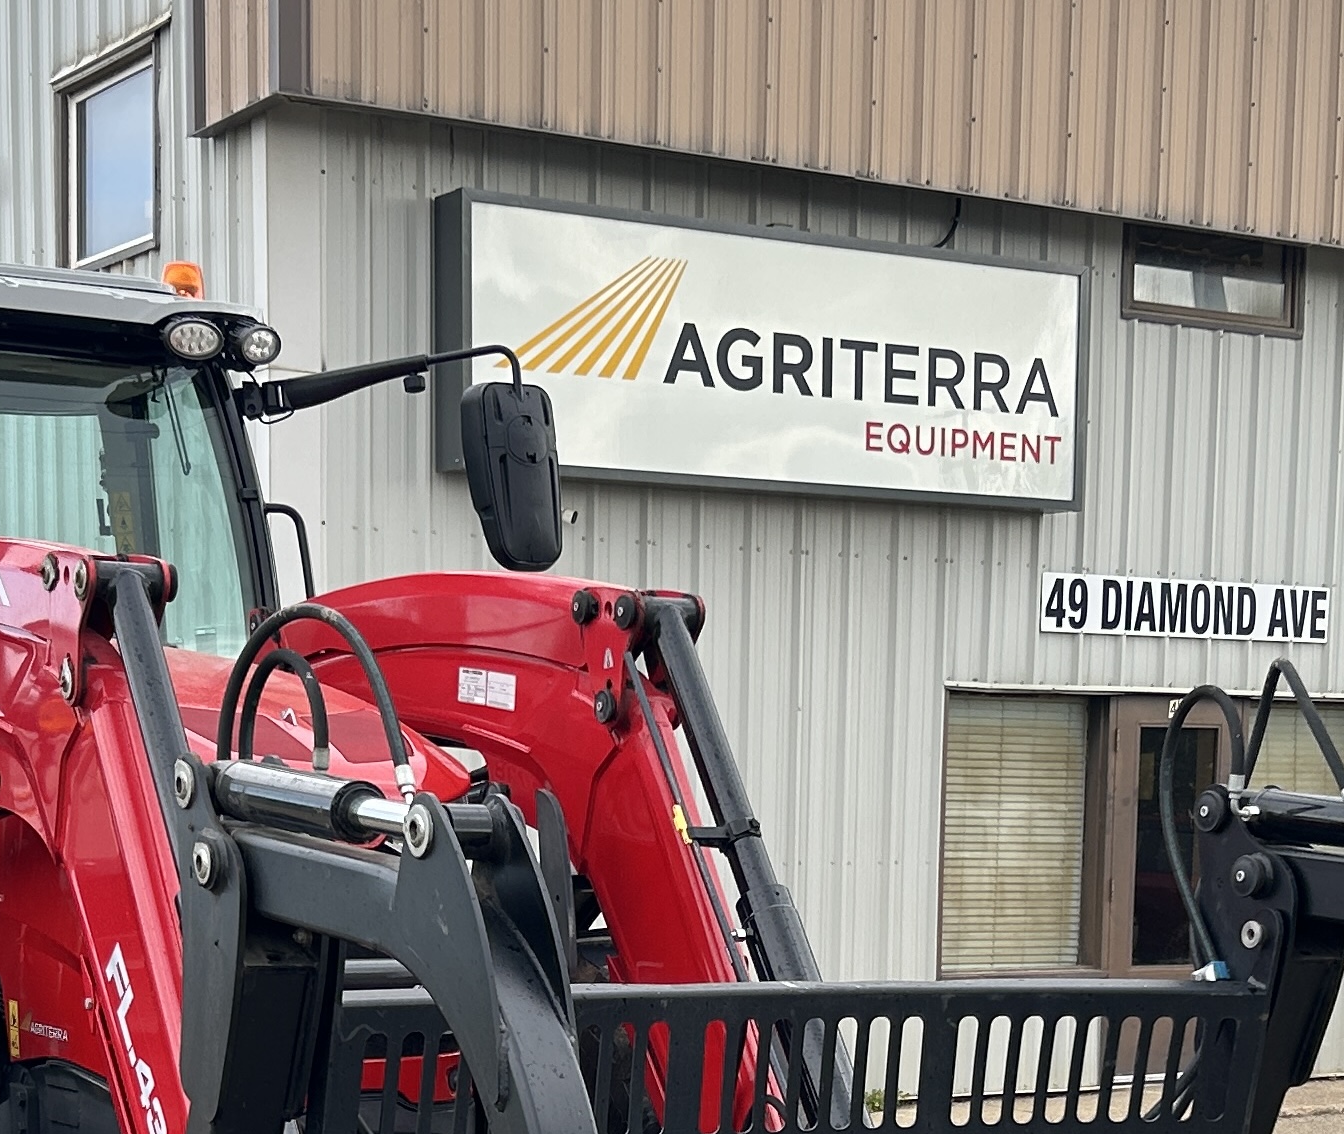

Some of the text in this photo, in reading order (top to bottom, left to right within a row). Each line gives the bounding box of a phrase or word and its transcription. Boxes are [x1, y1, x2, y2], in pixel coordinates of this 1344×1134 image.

[663, 322, 1059, 418] AGRITERRA
[865, 422, 1062, 465] EQUIPMENT
[1045, 578, 1327, 639] 49 DIAMOND AVE
